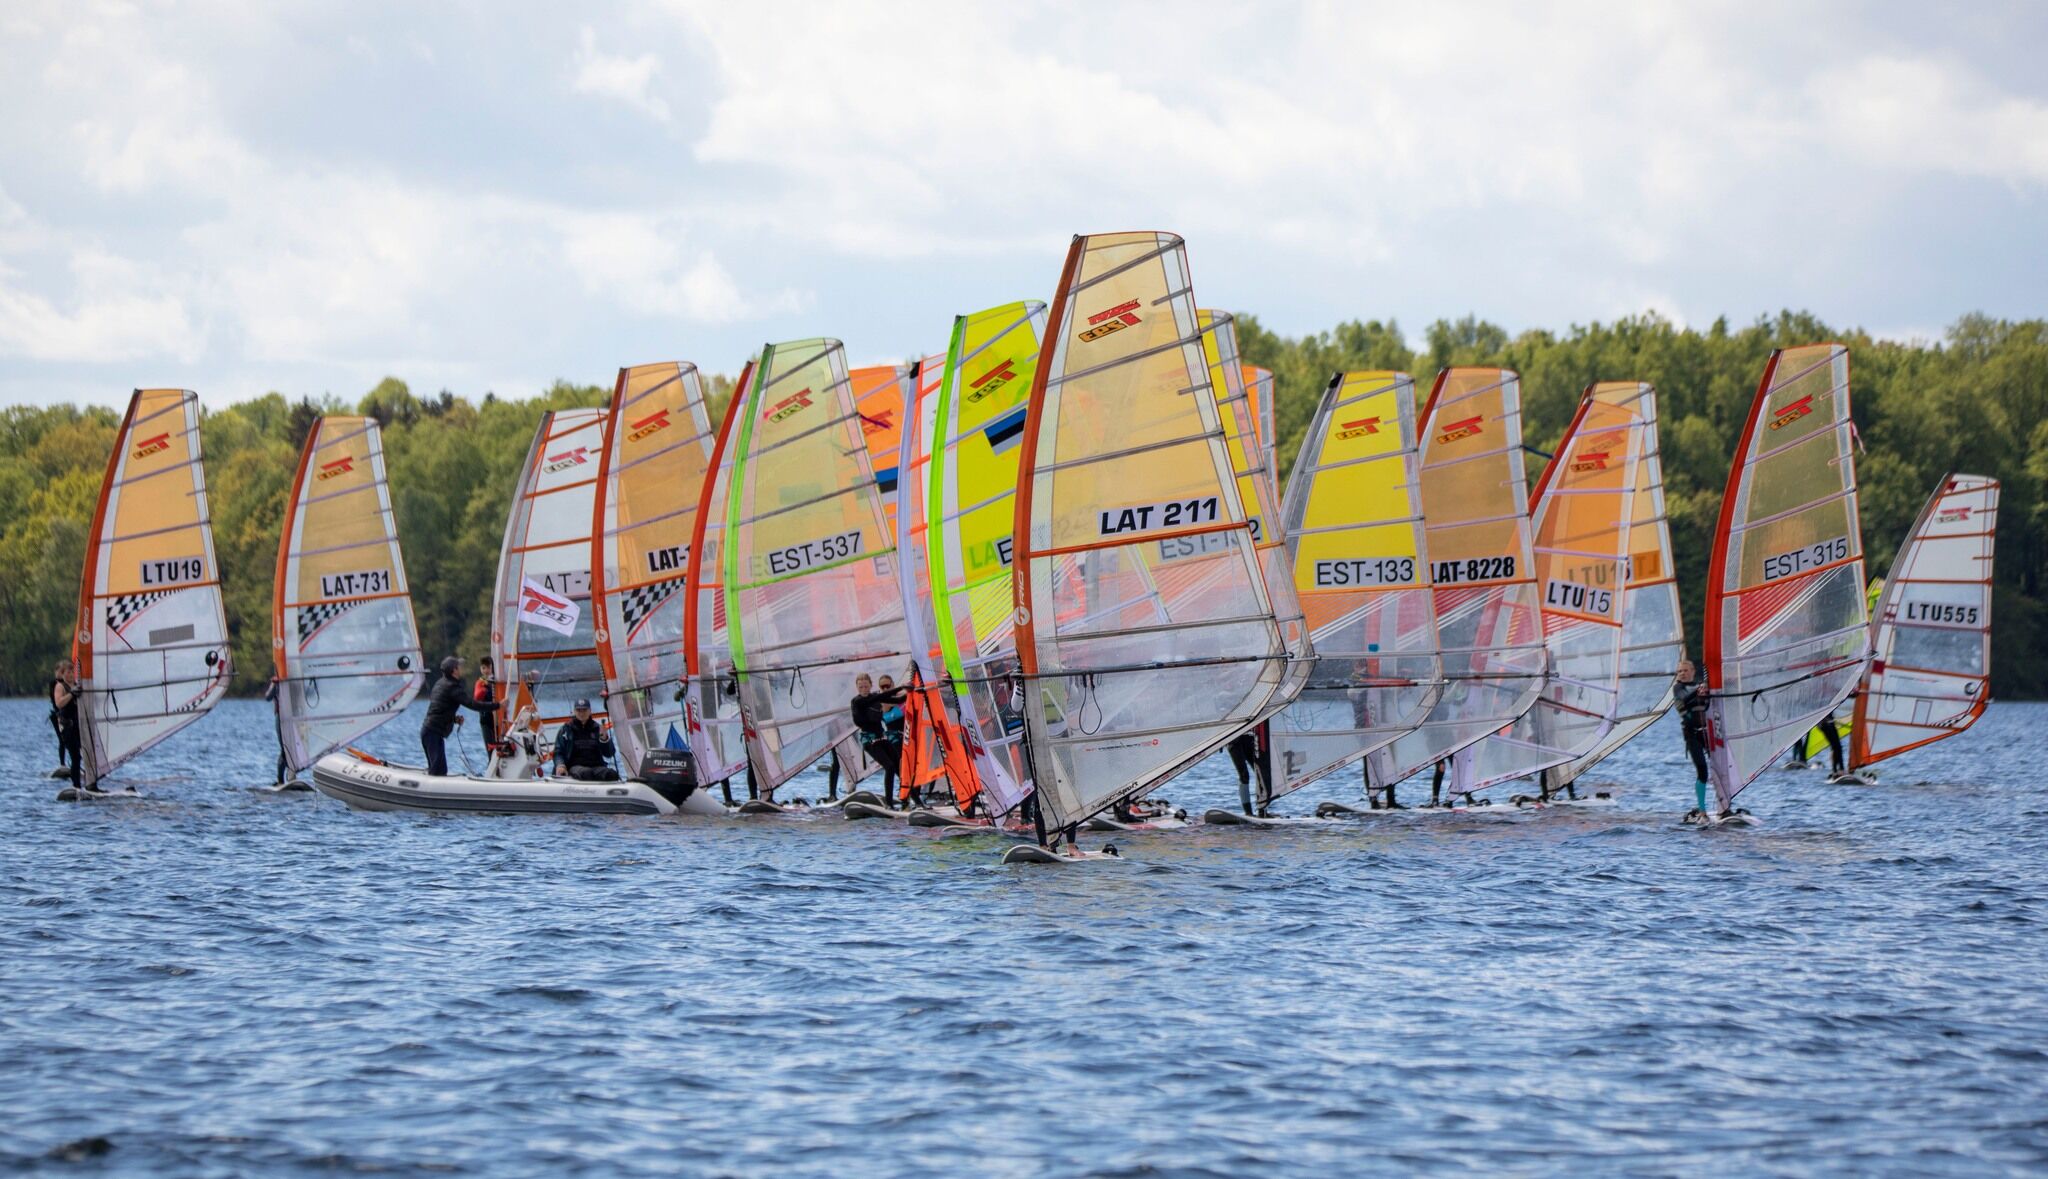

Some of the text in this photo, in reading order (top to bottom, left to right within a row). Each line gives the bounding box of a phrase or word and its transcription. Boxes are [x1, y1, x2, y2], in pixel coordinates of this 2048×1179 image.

[1101, 509, 1154, 535] LAT
[1163, 497, 1217, 526] 211
[769, 531, 860, 574] EST-537
[143, 559, 202, 584] LTU19
[322, 570, 389, 597] LAT-731
[1316, 559, 1413, 586] EST-133
[1431, 557, 1515, 584] LAT-8228
[1907, 602, 1978, 624] LTU555
